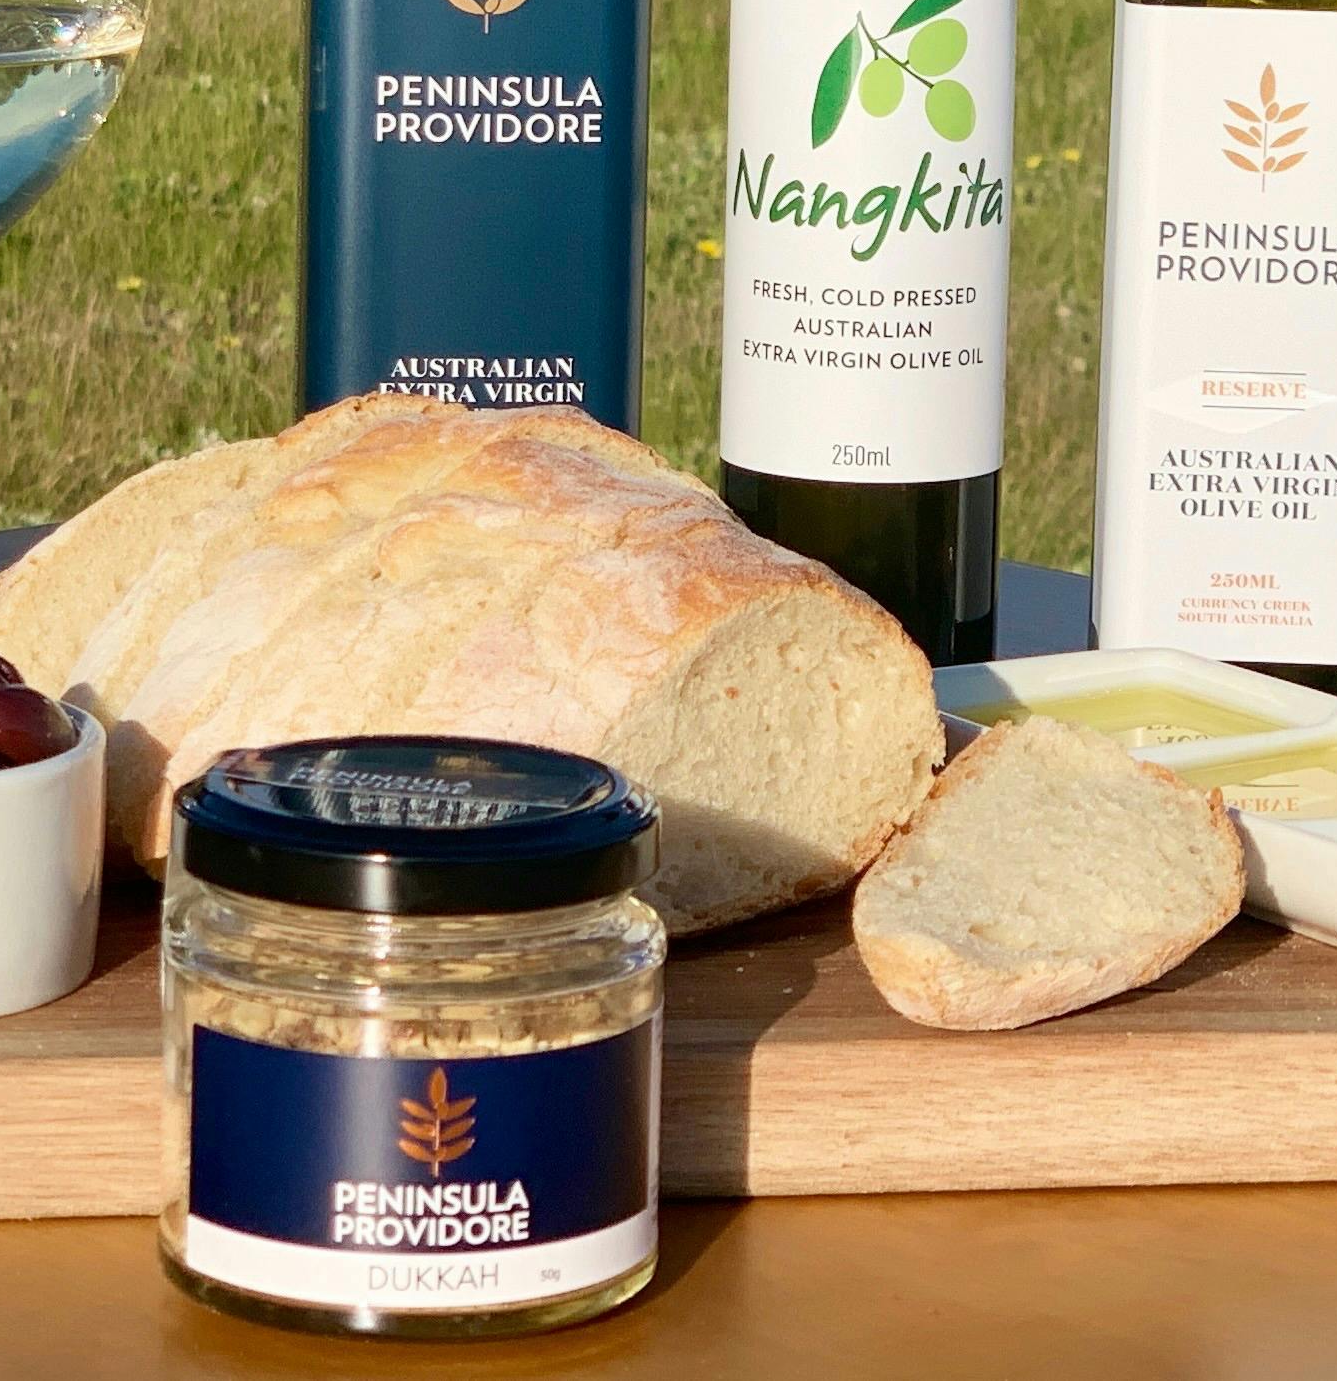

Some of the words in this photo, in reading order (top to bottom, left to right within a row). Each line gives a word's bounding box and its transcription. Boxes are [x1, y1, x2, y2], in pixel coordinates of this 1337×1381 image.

[376, 75, 603, 108] PENINSULA
[375, 113, 603, 144] PROVIDORE
[732, 147, 1003, 263] Nangkita
[752, 279, 815, 307] FRESH,
[821, 287, 885, 309] COLD
[893, 286, 977, 308] PRESSED
[793, 317, 932, 339] AUSTRALIAN
[391, 358, 574, 378] AUSTRALIAN
[743, 342, 797, 365] EXTRA
[803, 348, 882, 371] VIRGIN
[890, 349, 952, 370] OLIVE
[958, 347, 984, 368] OIL
[484, 382, 584, 403] VIRGIN
[1201, 379, 1308, 400] RESERVE
[831, 443, 892, 468] 250ml
[1149, 473, 1242, 494] EXTRA
[1180, 498, 1263, 520] OLIVE
[1272, 500, 1317, 521] OIL
[1210, 572, 1280, 590] 250ML
[1181, 597, 1258, 610] CURRENCY
[1263, 599, 1312, 612] CREEK
[1177, 611, 1227, 624] SOUTH
[1231, 613, 1314, 626] AUSTRALIA
[334, 1181, 530, 1217] PENINSULA
[334, 1211, 530, 1247] PROVIDORE
[368, 1263, 500, 1292] DUKKAH
